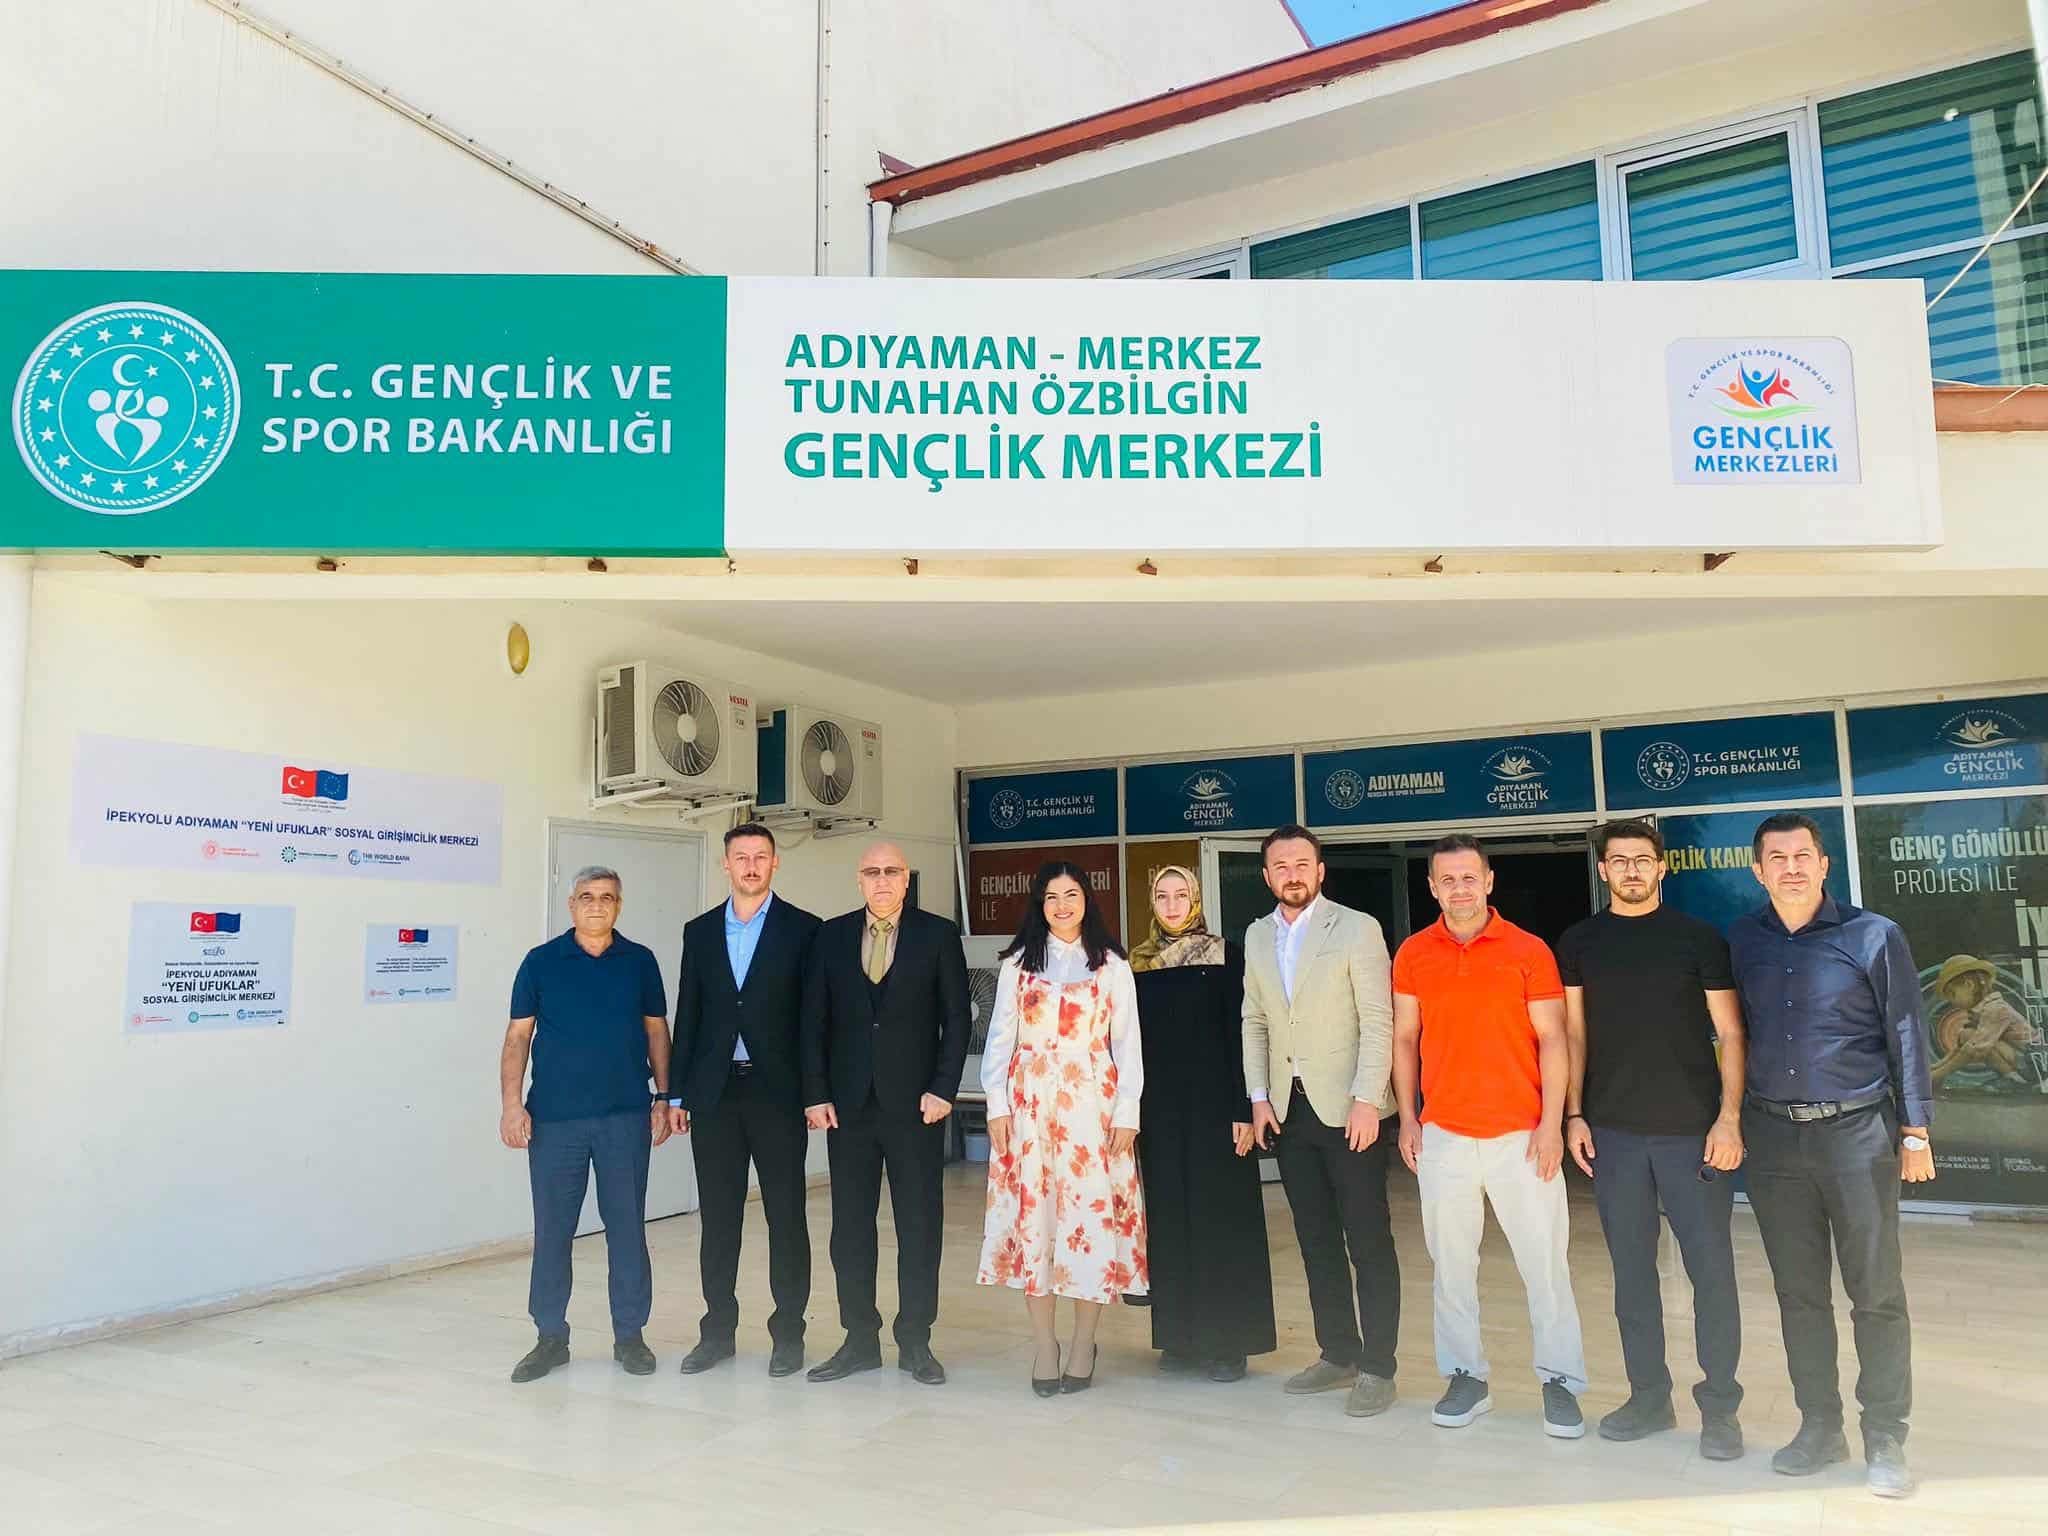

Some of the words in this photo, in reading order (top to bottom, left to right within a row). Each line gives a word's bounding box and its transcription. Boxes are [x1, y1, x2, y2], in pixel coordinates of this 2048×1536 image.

[785, 334, 1037, 369] ADIYAMAN
[1078, 336, 1262, 370] MERKEZ
[264, 362, 352, 399] T.C.
[371, 356, 591, 409] GENÇLİK
[612, 364, 672, 400] VE
[784, 379, 1018, 415] TUNAHAN
[1032, 373, 1248, 415] ÖZBİLGİN
[262, 416, 391, 454] SPOR
[407, 411, 672, 454] BAKANLIĞI
[1693, 424, 1833, 452] GENÇLİK
[784, 423, 1046, 493] GENÇLİK
[1062, 421, 1322, 479] MERKEZİ
[1695, 453, 1838, 472] MERKEZLERİ
[1693, 753, 1717, 763] T.C.
[1720, 747, 1778, 761] GENÇLİK
[1782, 746, 1800, 757] VE
[1952, 750, 2014, 762] ADIYAMAN
[1694, 764, 1728, 777] SPOR
[1731, 759, 1801, 775] BAKANLIĞI
[1368, 771, 1444, 791] ADIYAMAN
[1494, 783, 1541, 792] ADIYAMAN
[1026, 799, 1040, 807] T.C.
[1083, 795, 1095, 804] VE
[1501, 801, 1537, 810] MERKEZİ
[1026, 808, 1048, 819] SPOR
[106, 808, 172, 826] İPEKYOLU
[175, 815, 238, 830] ADIYAMAN
[334, 827, 375, 840] SOSYAL
[377, 830, 438, 844] GİRİŞİMCİLİK
[440, 835, 479, 847] MERKEZİ
[1664, 845, 1708, 875] ÇLİK
[1710, 846, 1753, 869] KAM
[1890, 835, 1946, 864] GENÇ
[981, 871, 1031, 897] GENÇLİK
[1894, 863, 1980, 896] PROJESİ
[1988, 862, 2019, 891] İLE
[981, 899, 1000, 921] İLE
[166, 969, 211, 979] İPEKYOLU
[213, 969, 257, 978] ADIYAMAN
[143, 995, 179, 1004] SOSYAL
[238, 991, 276, 1001] MERKEZİ
